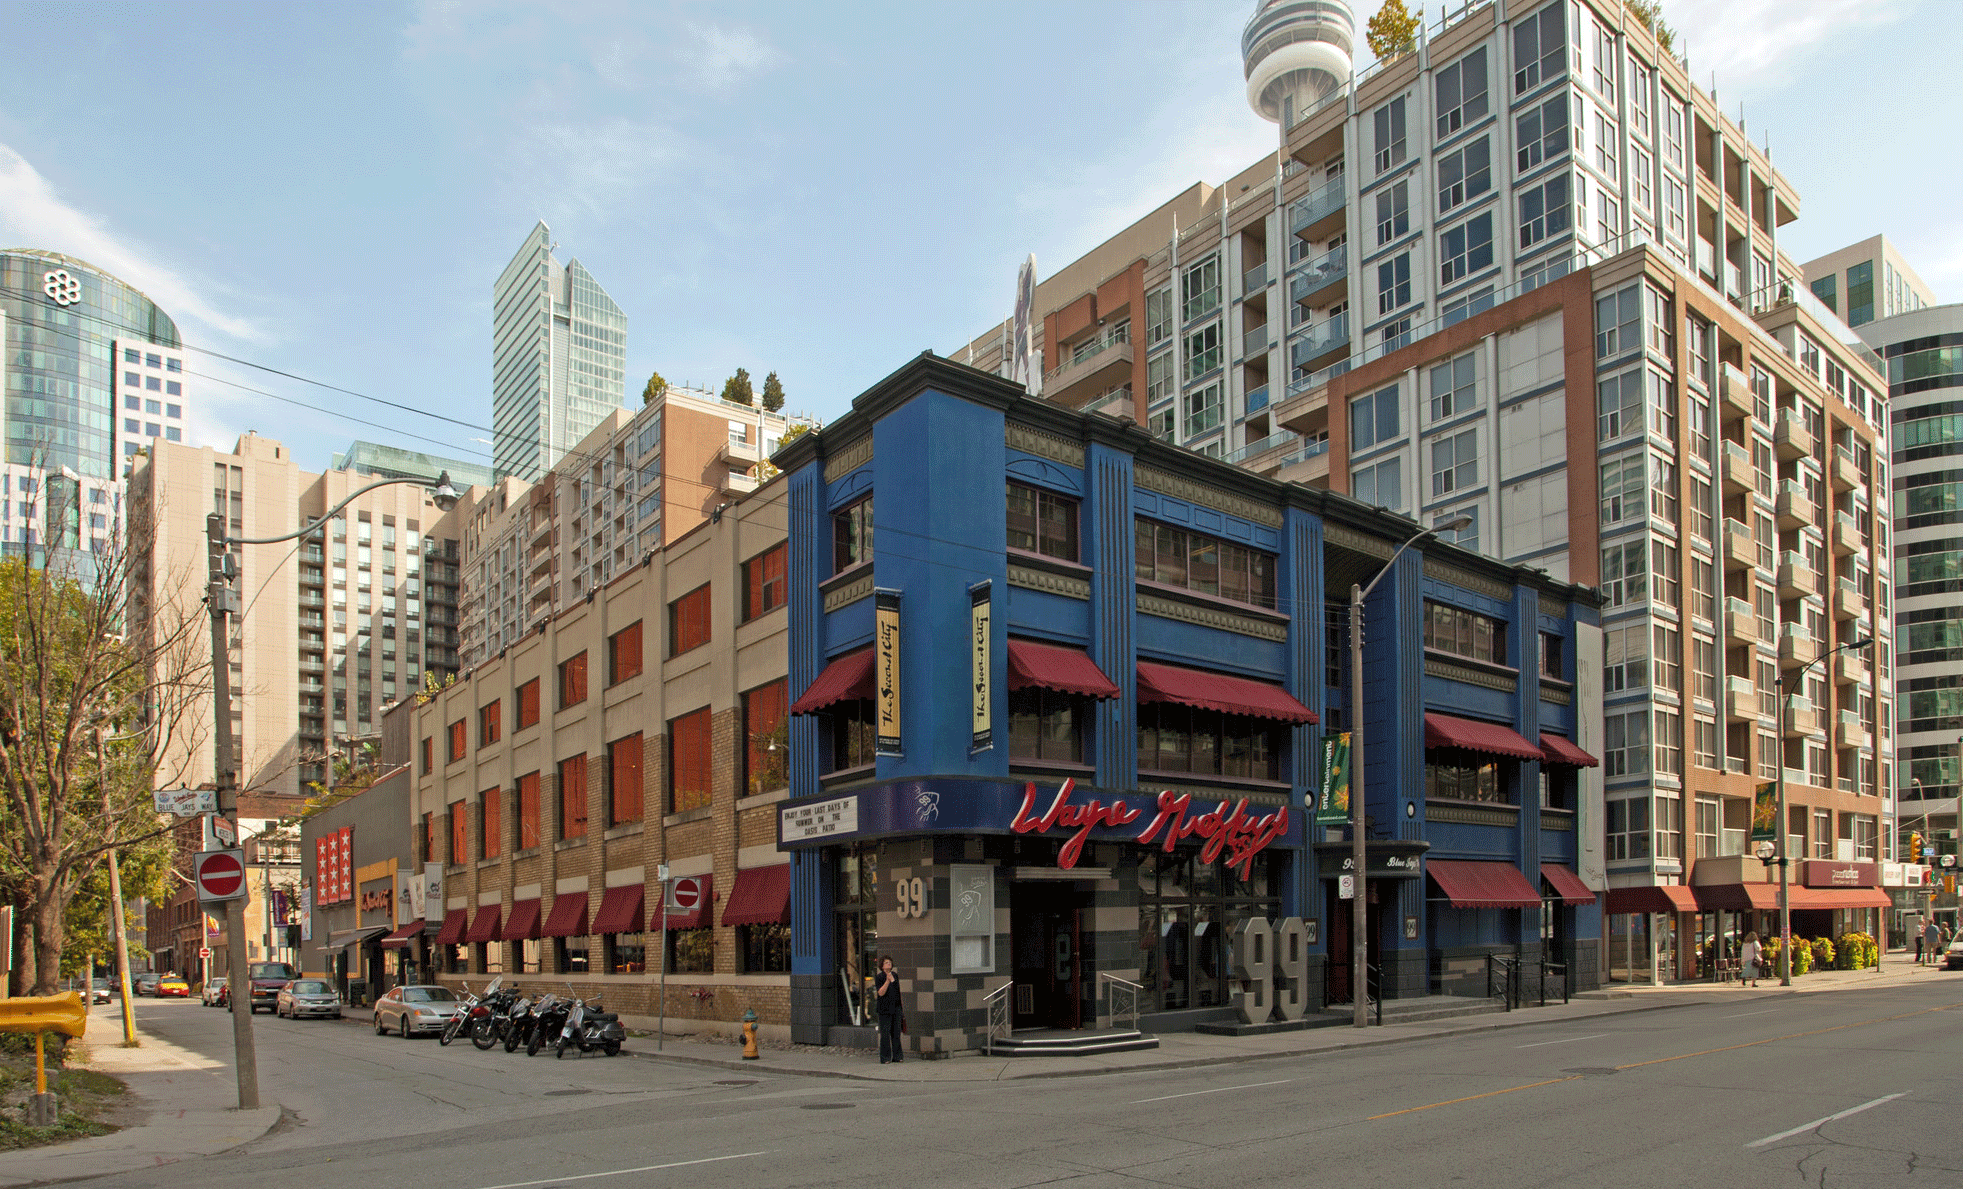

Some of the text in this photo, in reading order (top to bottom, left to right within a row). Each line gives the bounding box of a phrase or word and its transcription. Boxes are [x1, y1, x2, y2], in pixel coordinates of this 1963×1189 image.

[881, 620, 898, 650] City
[976, 616, 989, 645] City
[881, 652, 895, 699] Second
[976, 647, 986, 693] Second
[882, 701, 893, 727] The
[976, 694, 985, 722] The
[1322, 740, 1333, 810] entertainment
[158, 803, 174, 811] BLUE
[182, 803, 196, 811] JAYS
[784, 801, 850, 820] ENJOY YOUR LAST DAYS OF
[795, 813, 840, 827] SUMMER ON THE
[804, 823, 836, 835] OASIS PATIO
[1010, 777, 1142, 870] Wayne
[1386, 856, 1405, 867] Blue
[896, 877, 927, 918] 99
[1406, 921, 1416, 935] 99
[1233, 917, 1307, 1024] 99
